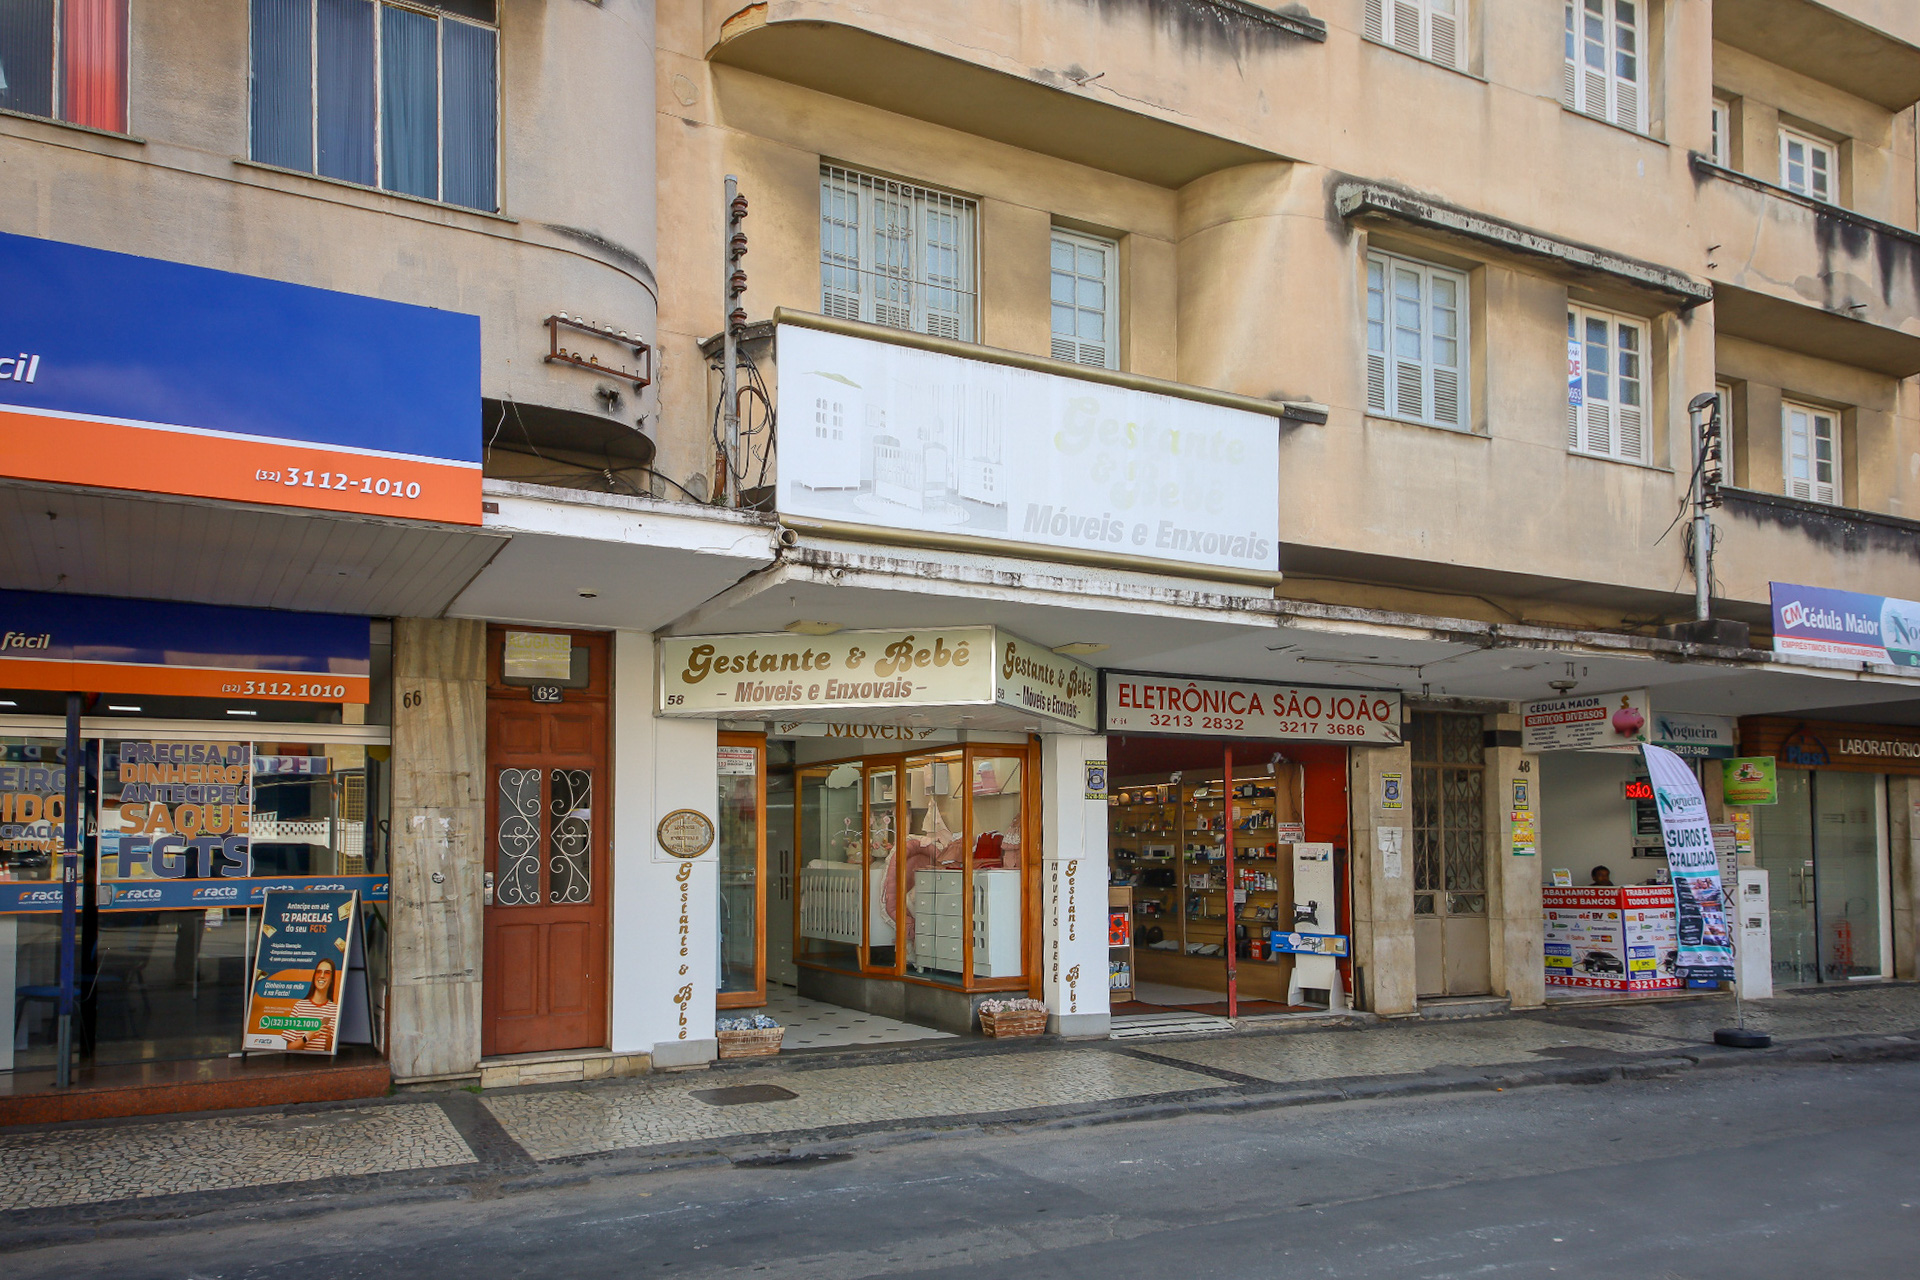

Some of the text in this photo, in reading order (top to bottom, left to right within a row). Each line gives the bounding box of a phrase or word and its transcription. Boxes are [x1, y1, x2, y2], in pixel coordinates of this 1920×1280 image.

[1054, 396, 1246, 466] Gestante
[255, 467, 422, 500] (32) 3112-1010
[1023, 504, 1270, 561] Móveis e Enxovais
[1782, 605, 1920, 646] CM Cédula Maior No
[0, 631, 50, 651] fácil
[508, 634, 570, 651] ALUGA-SE
[681, 635, 970, 684] Gestante & Bebê
[1827, 645, 1833, 653] E
[1833, 646, 1886, 659] FINANCIAMENTOS
[1002, 641, 1092, 700] Gestante & Bebê
[221, 681, 346, 699] (32) 3112.1010
[537, 686, 559, 700] 62
[735, 677, 913, 703] Móveis e Enxovais
[997, 687, 1005, 700] 58
[402, 690, 422, 709] 66
[667, 695, 684, 705] 58
[1022, 684, 1078, 719] Móveis e Enxovais
[1118, 682, 1391, 722] ELETRÔNICA SÃO JOÃO
[1568, 698, 1600, 710] MAIOR
[1150, 714, 1366, 737] 3213 2832 3217 3686
[1527, 709, 1605, 726] SERVIÇOS DIVERSOS
[1659, 720, 1718, 741] Nogueira
[119, 742, 222, 764] PRECISA
[227, 744, 257, 765] DE
[1675, 745, 1709, 756] 3217-3482
[1839, 738, 1920, 758] LABORATÓRIO
[119, 783, 235, 803] ANTECIPE
[119, 803, 256, 841] SAQUE
[0, 839, 65, 852] ETITIVAS
[1666, 827, 1710, 848] GUROS E
[118, 836, 255, 879] FGTS
[127, 888, 162, 900] facta
[204, 886, 238, 898] facta
[1065, 859, 1078, 942] Gestante
[1598, 889, 1619, 897] COM
[1625, 888, 1671, 897] TRABALHAMOS
[287, 902, 310, 911] Antecipe
[320, 902, 330, 910] até
[675, 861, 693, 957] Gestante
[1580, 898, 1616, 906] BANCOS
[1628, 898, 1649, 906] TODOS
[281, 912, 333, 923] 12 PARCELAS
[1592, 912, 1604, 920] BV
[285, 924, 327, 933] do seu FGTS
[678, 964, 689, 976] &
[1065, 964, 1080, 1013] Bebê
[1546, 975, 1621, 989] 3217-3482
[673, 983, 693, 1040] Bebê
[270, 1018, 320, 1028] (32) 3112.1010
